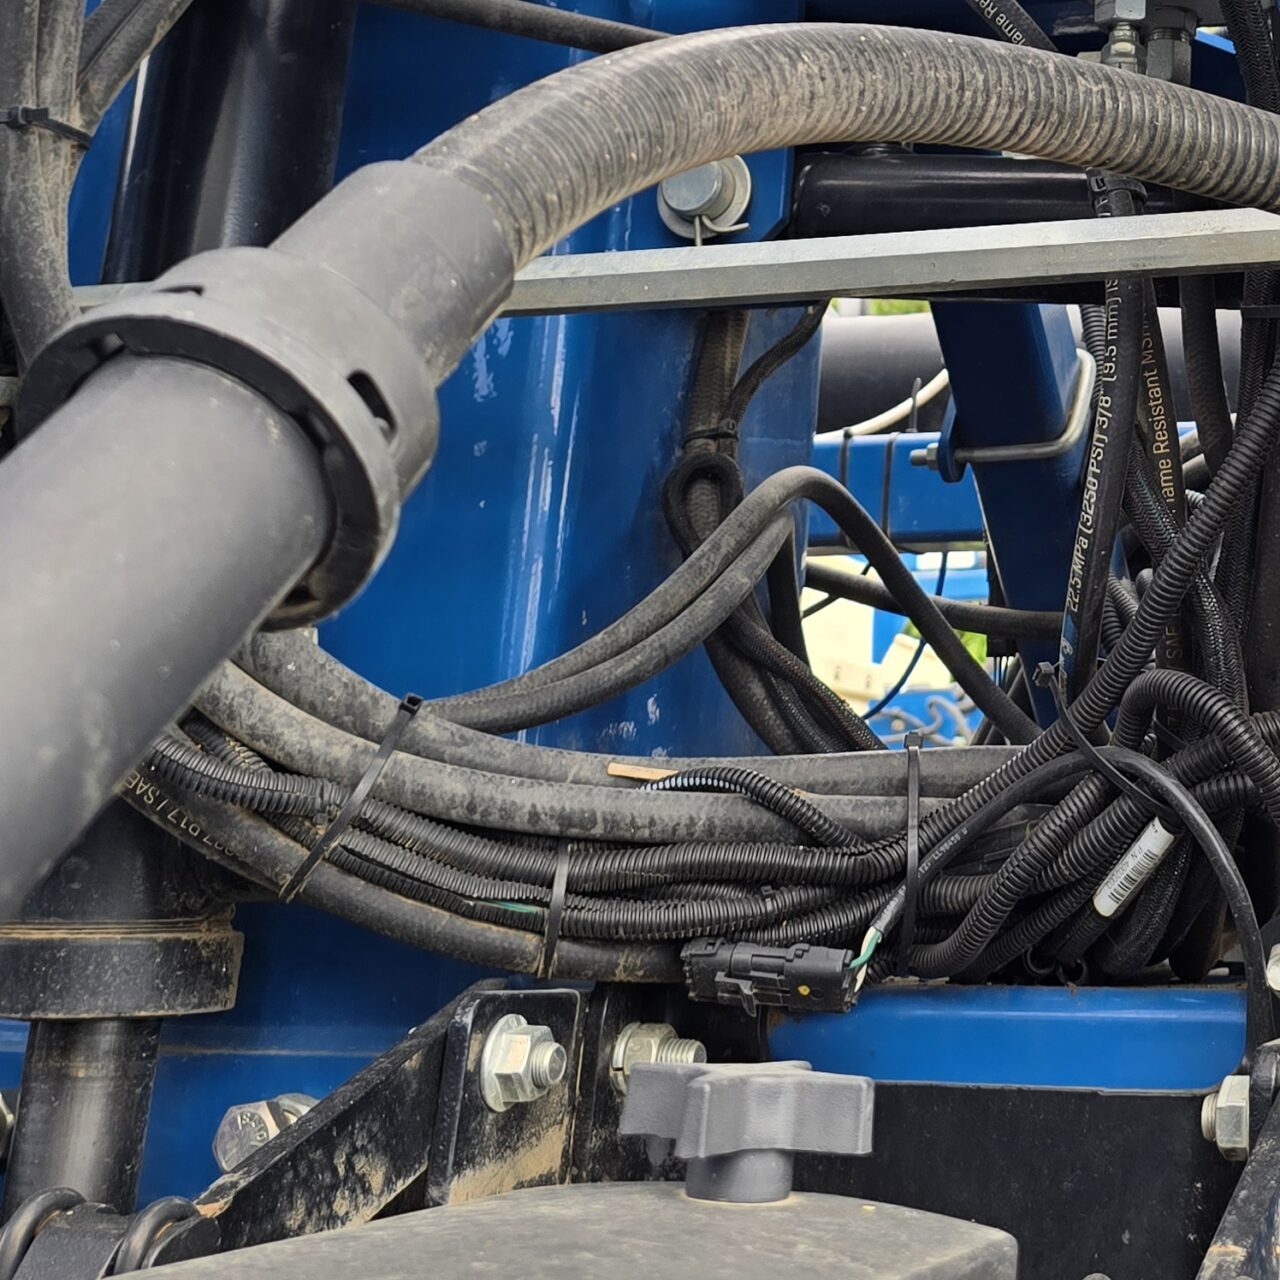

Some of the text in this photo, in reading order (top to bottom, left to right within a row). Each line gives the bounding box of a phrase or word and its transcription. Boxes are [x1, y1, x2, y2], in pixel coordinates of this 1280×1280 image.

[1144, 370, 1170, 454] Resistant
[1071, 538, 1088, 573] MPa
[1068, 575, 1082, 612] 22.5
[123, 769, 159, 804] SAE
